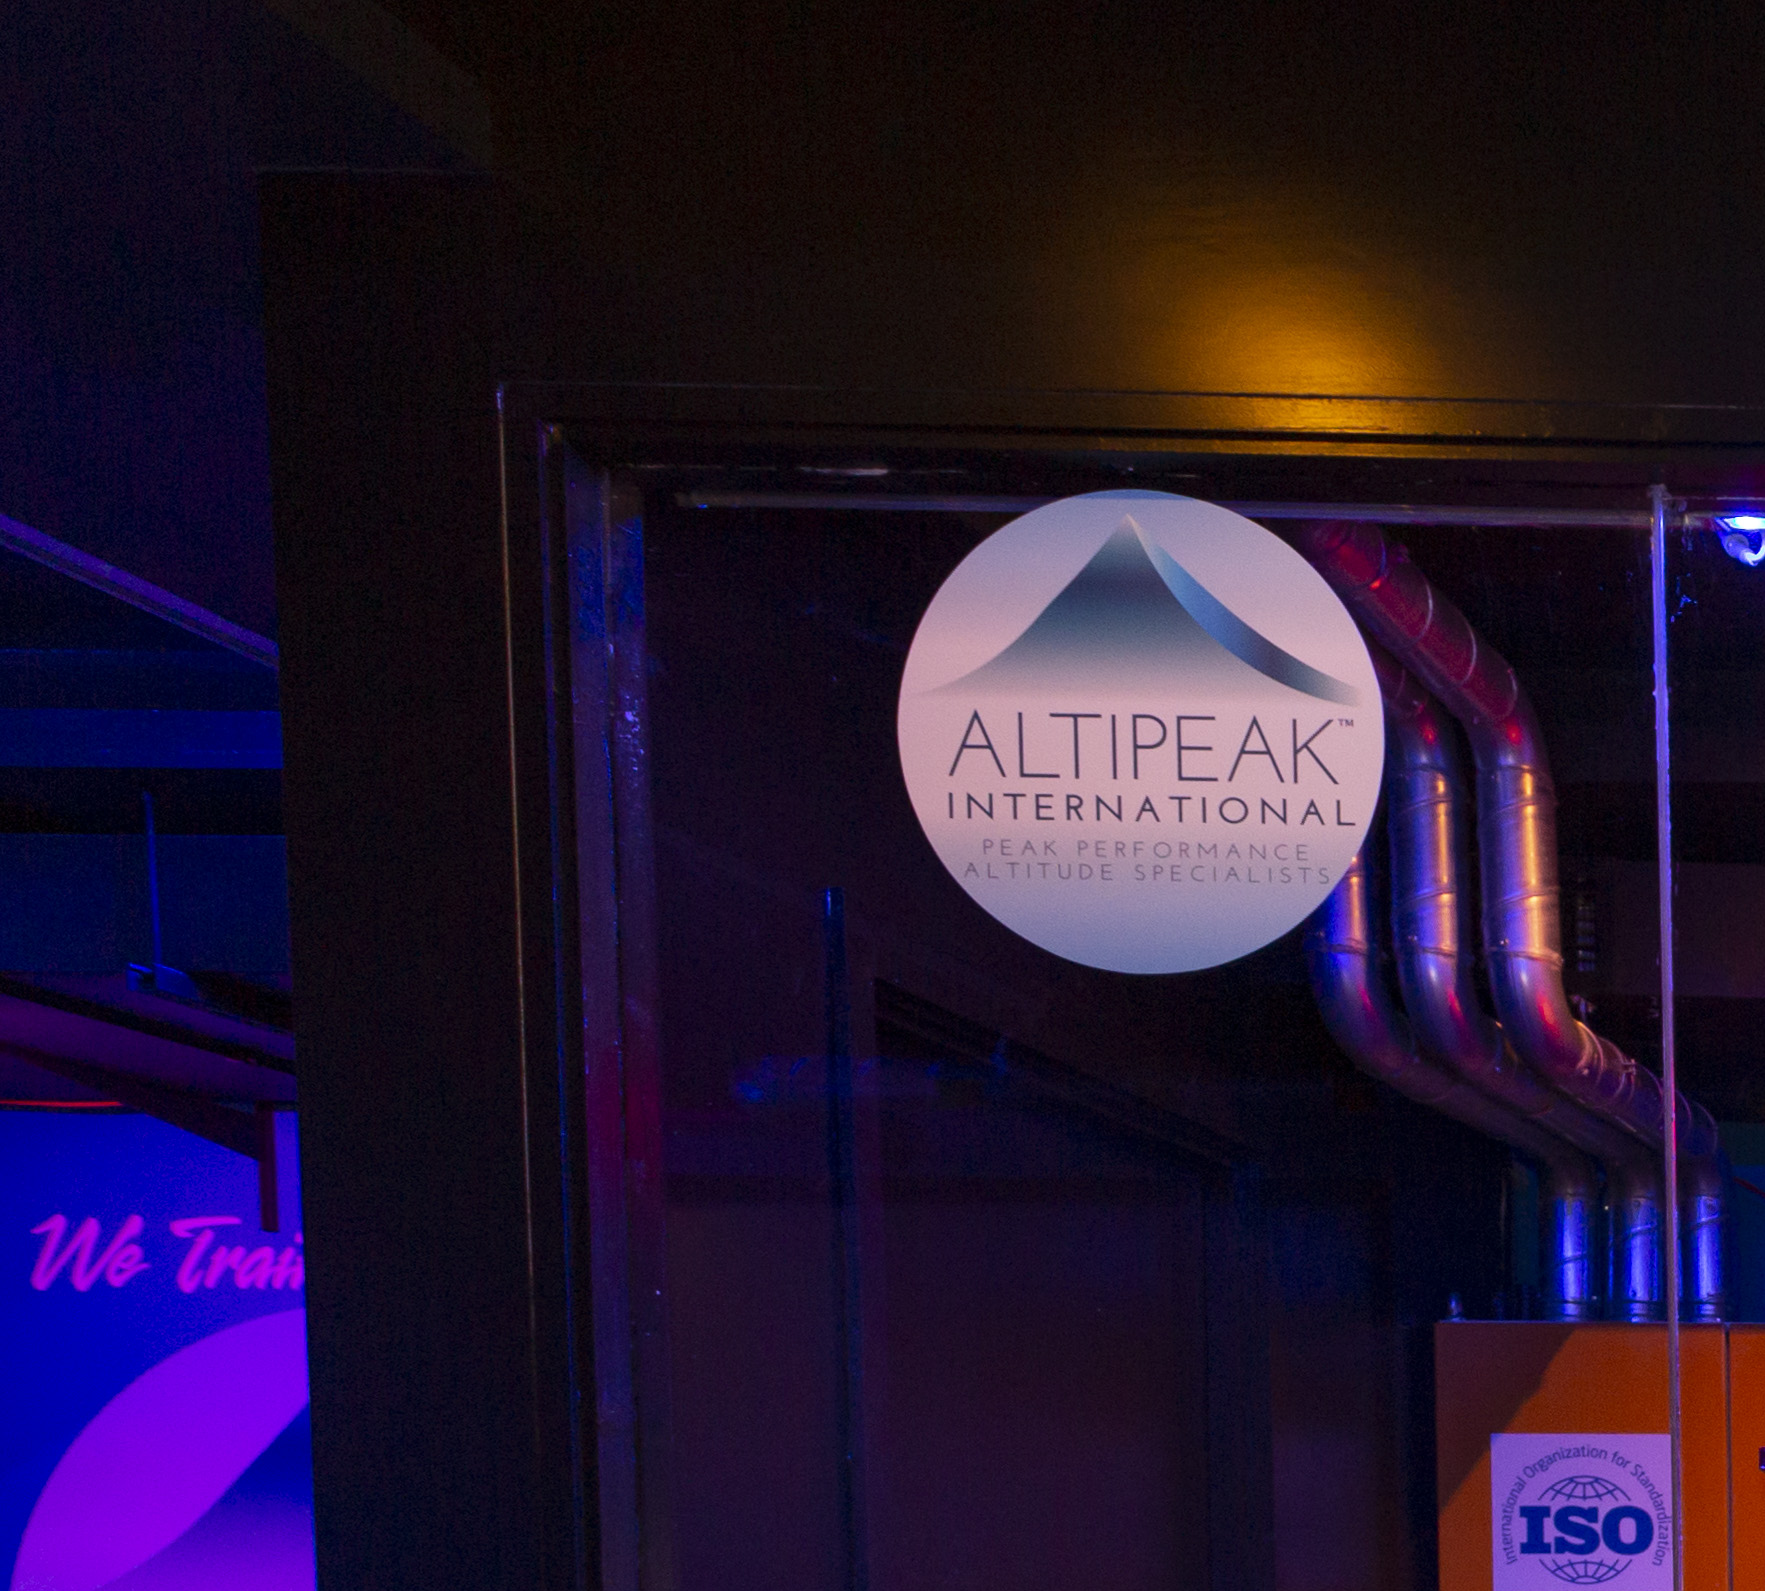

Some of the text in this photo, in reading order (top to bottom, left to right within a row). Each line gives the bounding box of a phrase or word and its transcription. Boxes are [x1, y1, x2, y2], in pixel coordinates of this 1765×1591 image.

[948, 792, 1356, 826] INTERNATIONAL
[982, 838, 1309, 862] PEAK PERFORMANCE
[964, 862, 1330, 885] ALTITUDE SPECIALISTS
[30, 1214, 150, 1292] We
[1501, 1444, 1672, 1567] International Organization for Standardization
[1519, 1505, 1654, 1555] ISO
